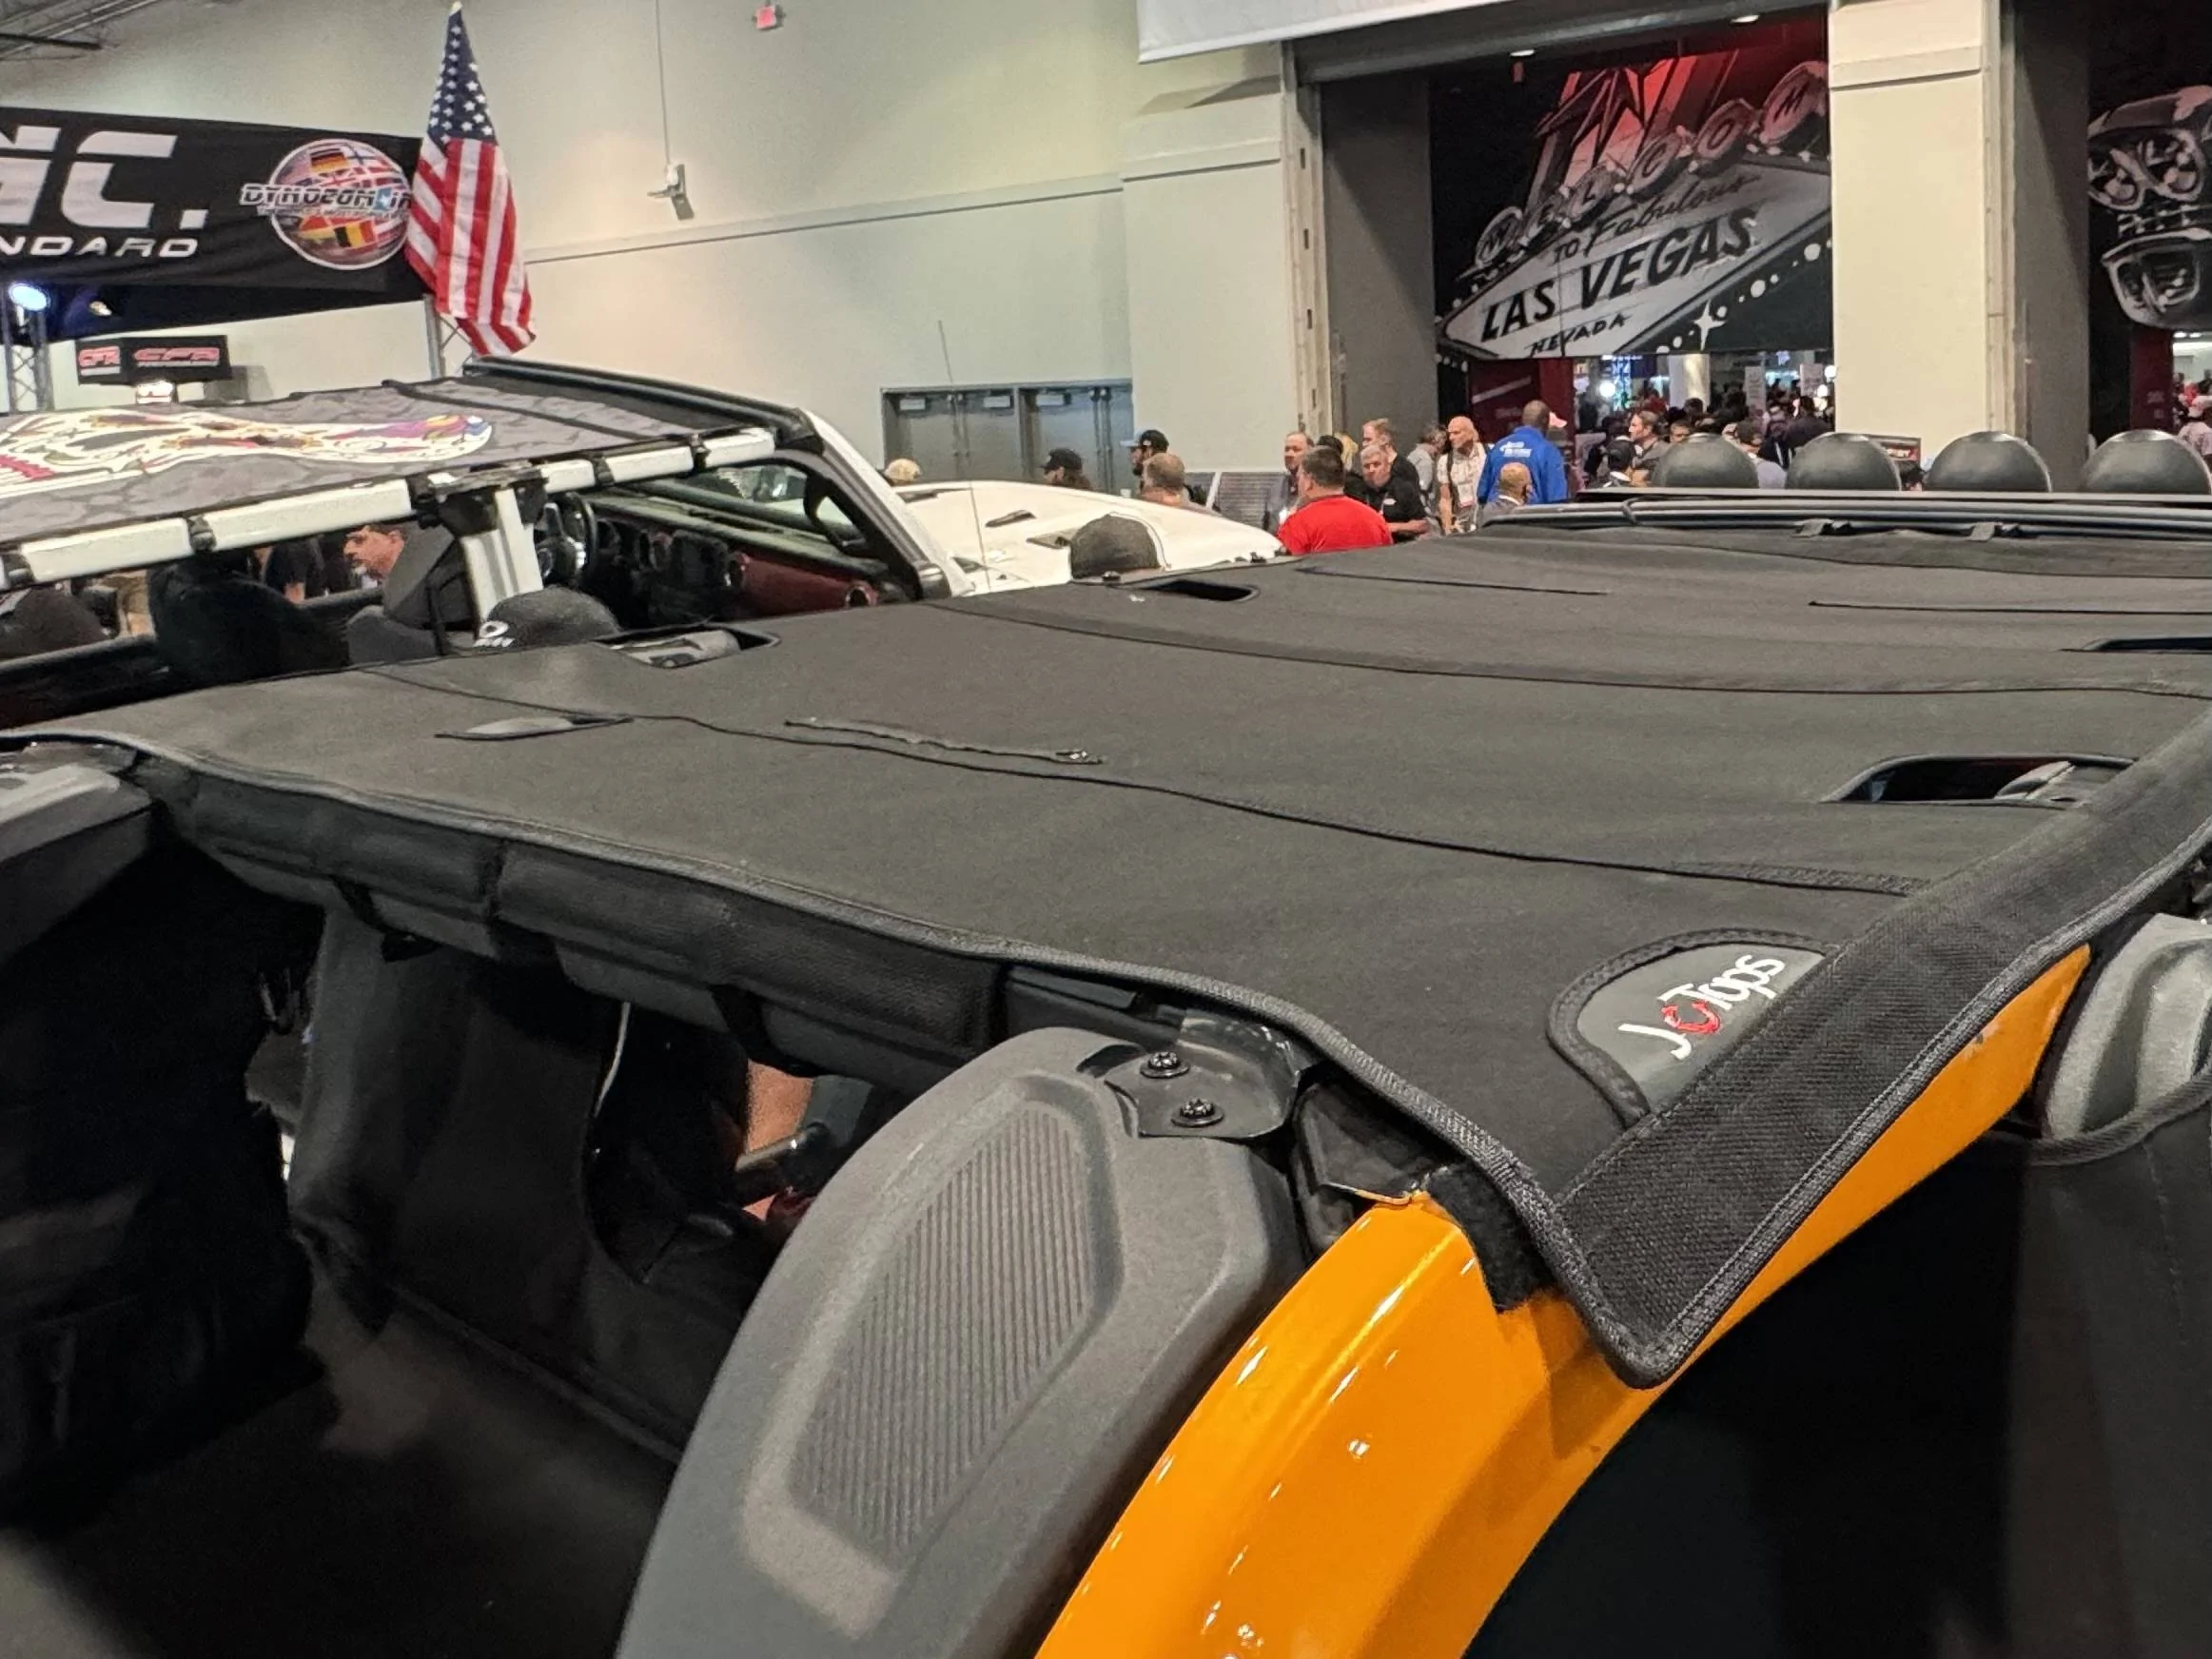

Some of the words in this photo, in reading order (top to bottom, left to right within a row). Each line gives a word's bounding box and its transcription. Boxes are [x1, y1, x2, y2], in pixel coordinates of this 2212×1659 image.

[1480, 279, 1556, 342] LAS
[1580, 207, 1757, 309] VEGAS
[1525, 312, 1632, 357] NEVADA
